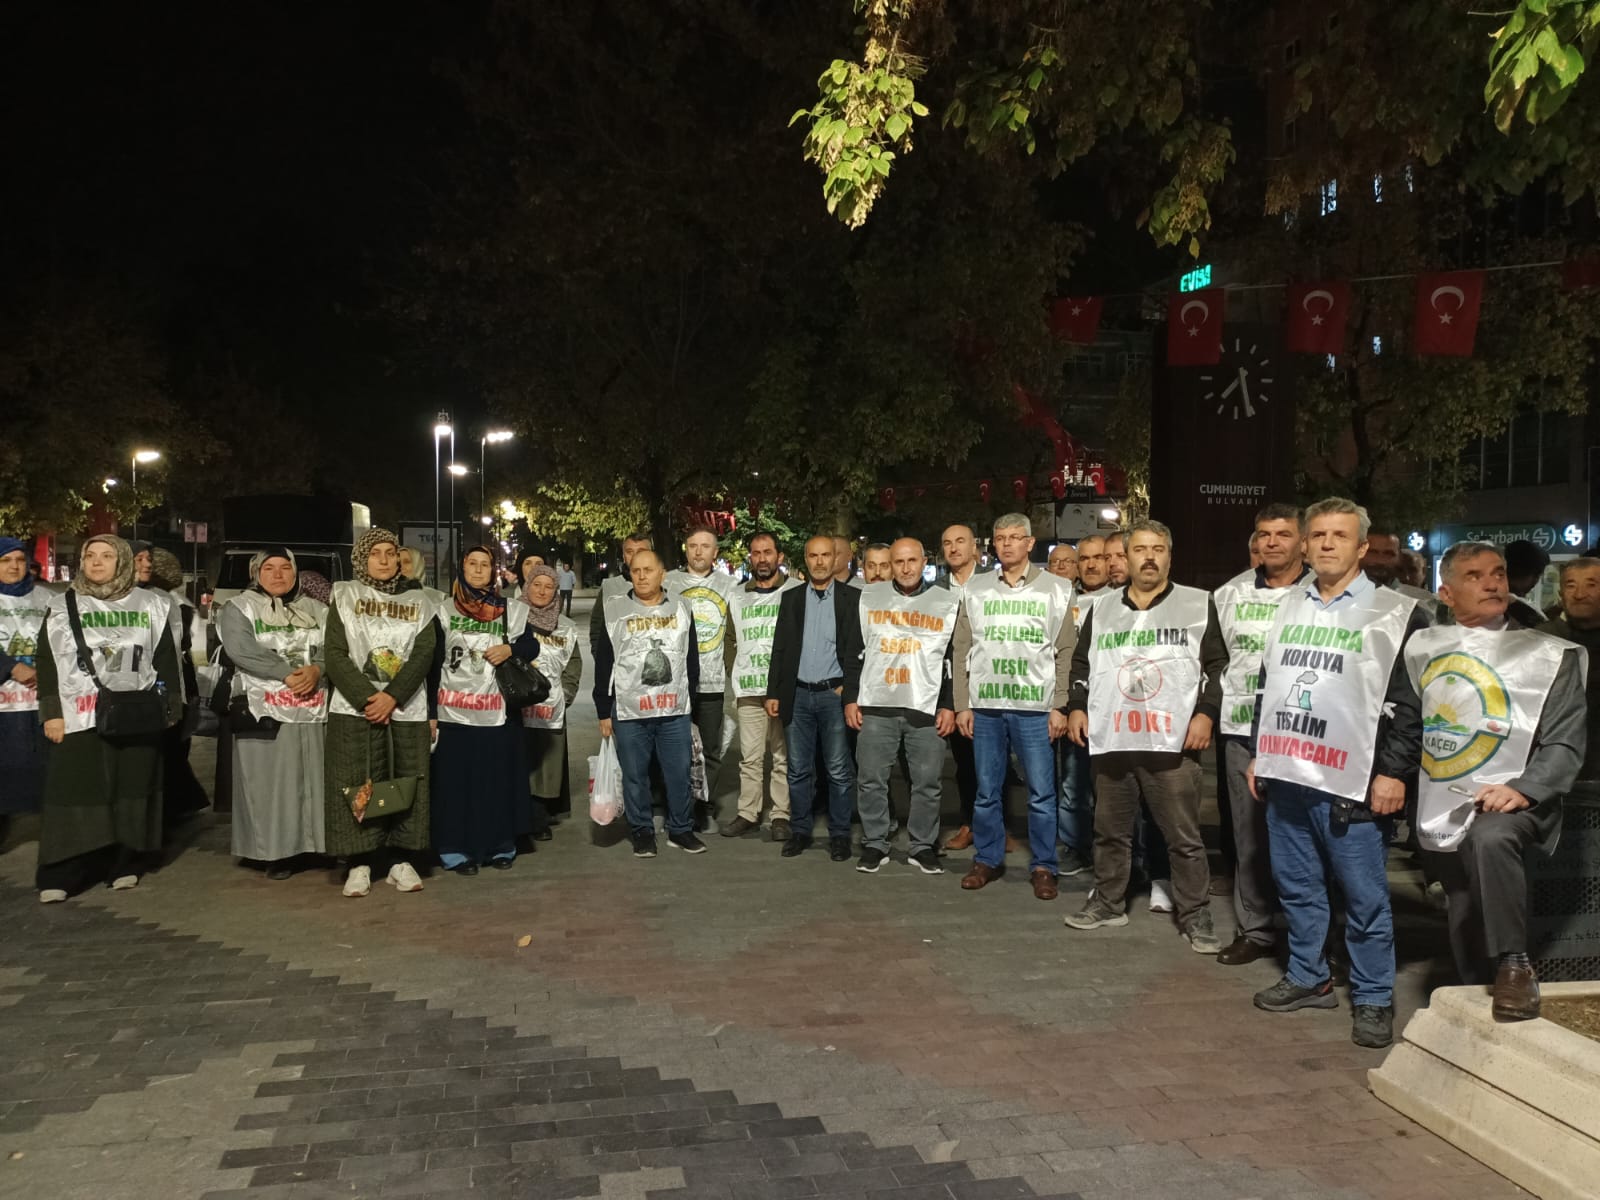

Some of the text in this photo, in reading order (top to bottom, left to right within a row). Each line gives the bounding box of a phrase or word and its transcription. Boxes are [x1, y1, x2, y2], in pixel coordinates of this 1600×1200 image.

[1207, 497, 1258, 505] BULVARI
[355, 598, 419, 622] ÇÖPÜNÜ
[983, 599, 1046, 618] KANDIRA
[81, 610, 150, 630] ANDIRA
[867, 609, 944, 632] TOPRAĞINA
[984, 624, 1044, 644] YEŞİLDİR
[1278, 624, 1363, 653] KANDIRA
[880, 637, 921, 655] SAHİP
[992, 657, 1028, 679] YEŞİL
[1280, 648, 1344, 674] KOKUYA
[739, 674, 767, 689] KALA
[885, 667, 911, 685] ÇIK!
[639, 693, 678, 711] AL GİT!
[978, 683, 1044, 702] KALACAK!
[1276, 711, 1328, 739] TESLİM
[1424, 736, 1457, 753] KAÇED
